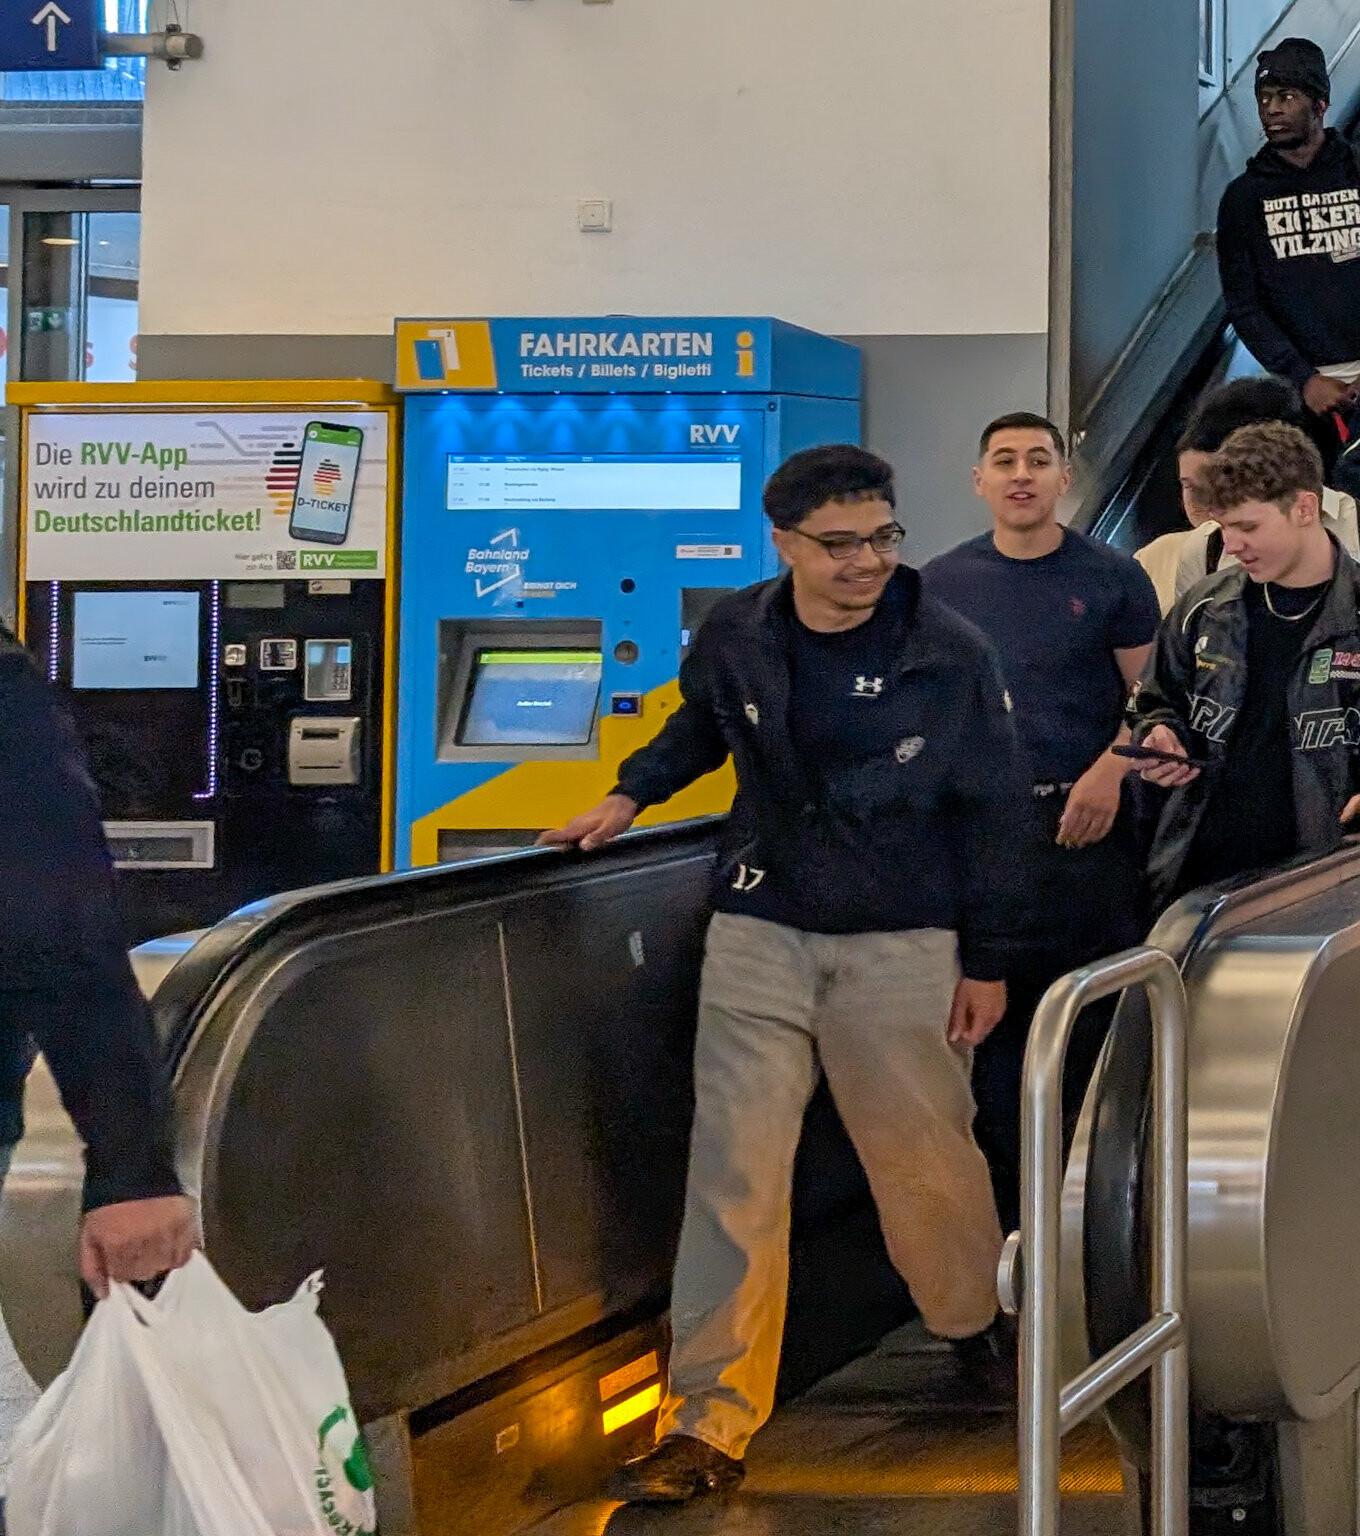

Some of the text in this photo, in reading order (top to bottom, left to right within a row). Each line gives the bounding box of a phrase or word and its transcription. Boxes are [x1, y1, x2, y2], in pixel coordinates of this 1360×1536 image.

[520, 332, 713, 357] FAHRKARTEN
[521, 364, 712, 380] Tickets Billets Biglietti
[690, 424, 740, 444] RVV
[36, 442, 189, 471] Die RVV-App
[34, 475, 216, 500] wird zu deinem
[297, 496, 350, 513] D-TICKET
[34, 507, 262, 533] Deutschlandticket!
[303, 554, 336, 567] RVV
[467, 548, 530, 562] Bahnland
[465, 562, 510, 576] Bayern
[734, 865, 765, 892] 17
